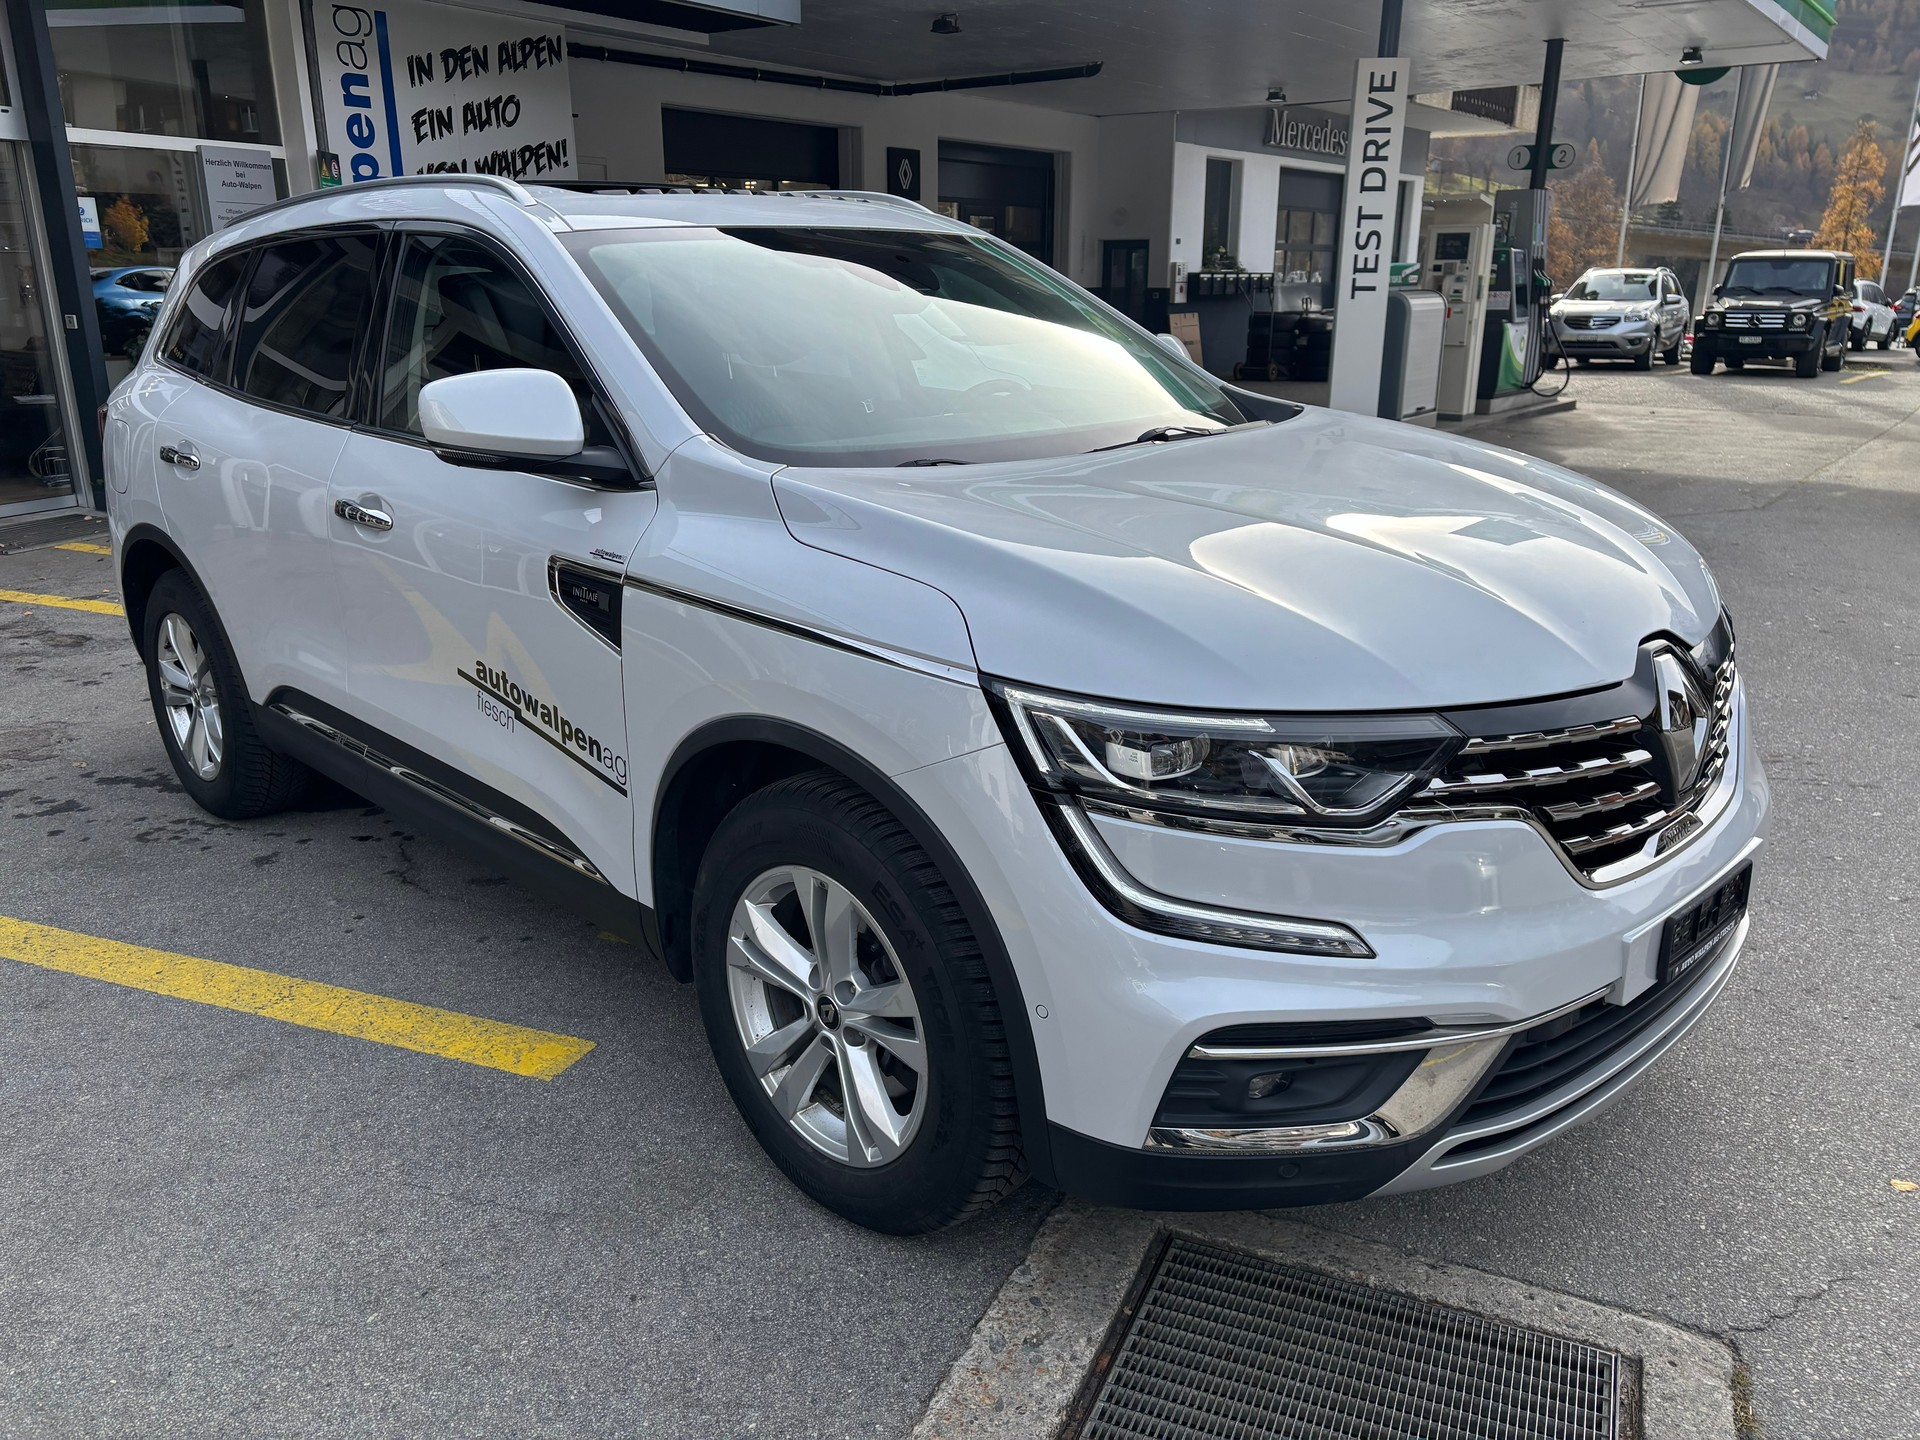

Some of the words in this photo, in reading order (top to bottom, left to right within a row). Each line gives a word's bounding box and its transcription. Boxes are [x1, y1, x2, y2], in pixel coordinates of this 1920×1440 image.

[406, 52, 434, 88] IN
[440, 44, 490, 83] DEN
[497, 34, 563, 76] ALPEN
[411, 105, 454, 145] EIN
[462, 94, 521, 136] AUTO
[1359, 71, 1397, 193] DRIVE
[205, 158, 232, 167] Herzlich
[232, 160, 272, 170] Willkommen
[1516, 151, 1521, 164] 1
[1558, 150, 1567, 163] 2
[221, 181, 262, 190] Auto-Walpen
[1350, 206, 1383, 299] TEST
[476, 690, 515, 733] fiesch
